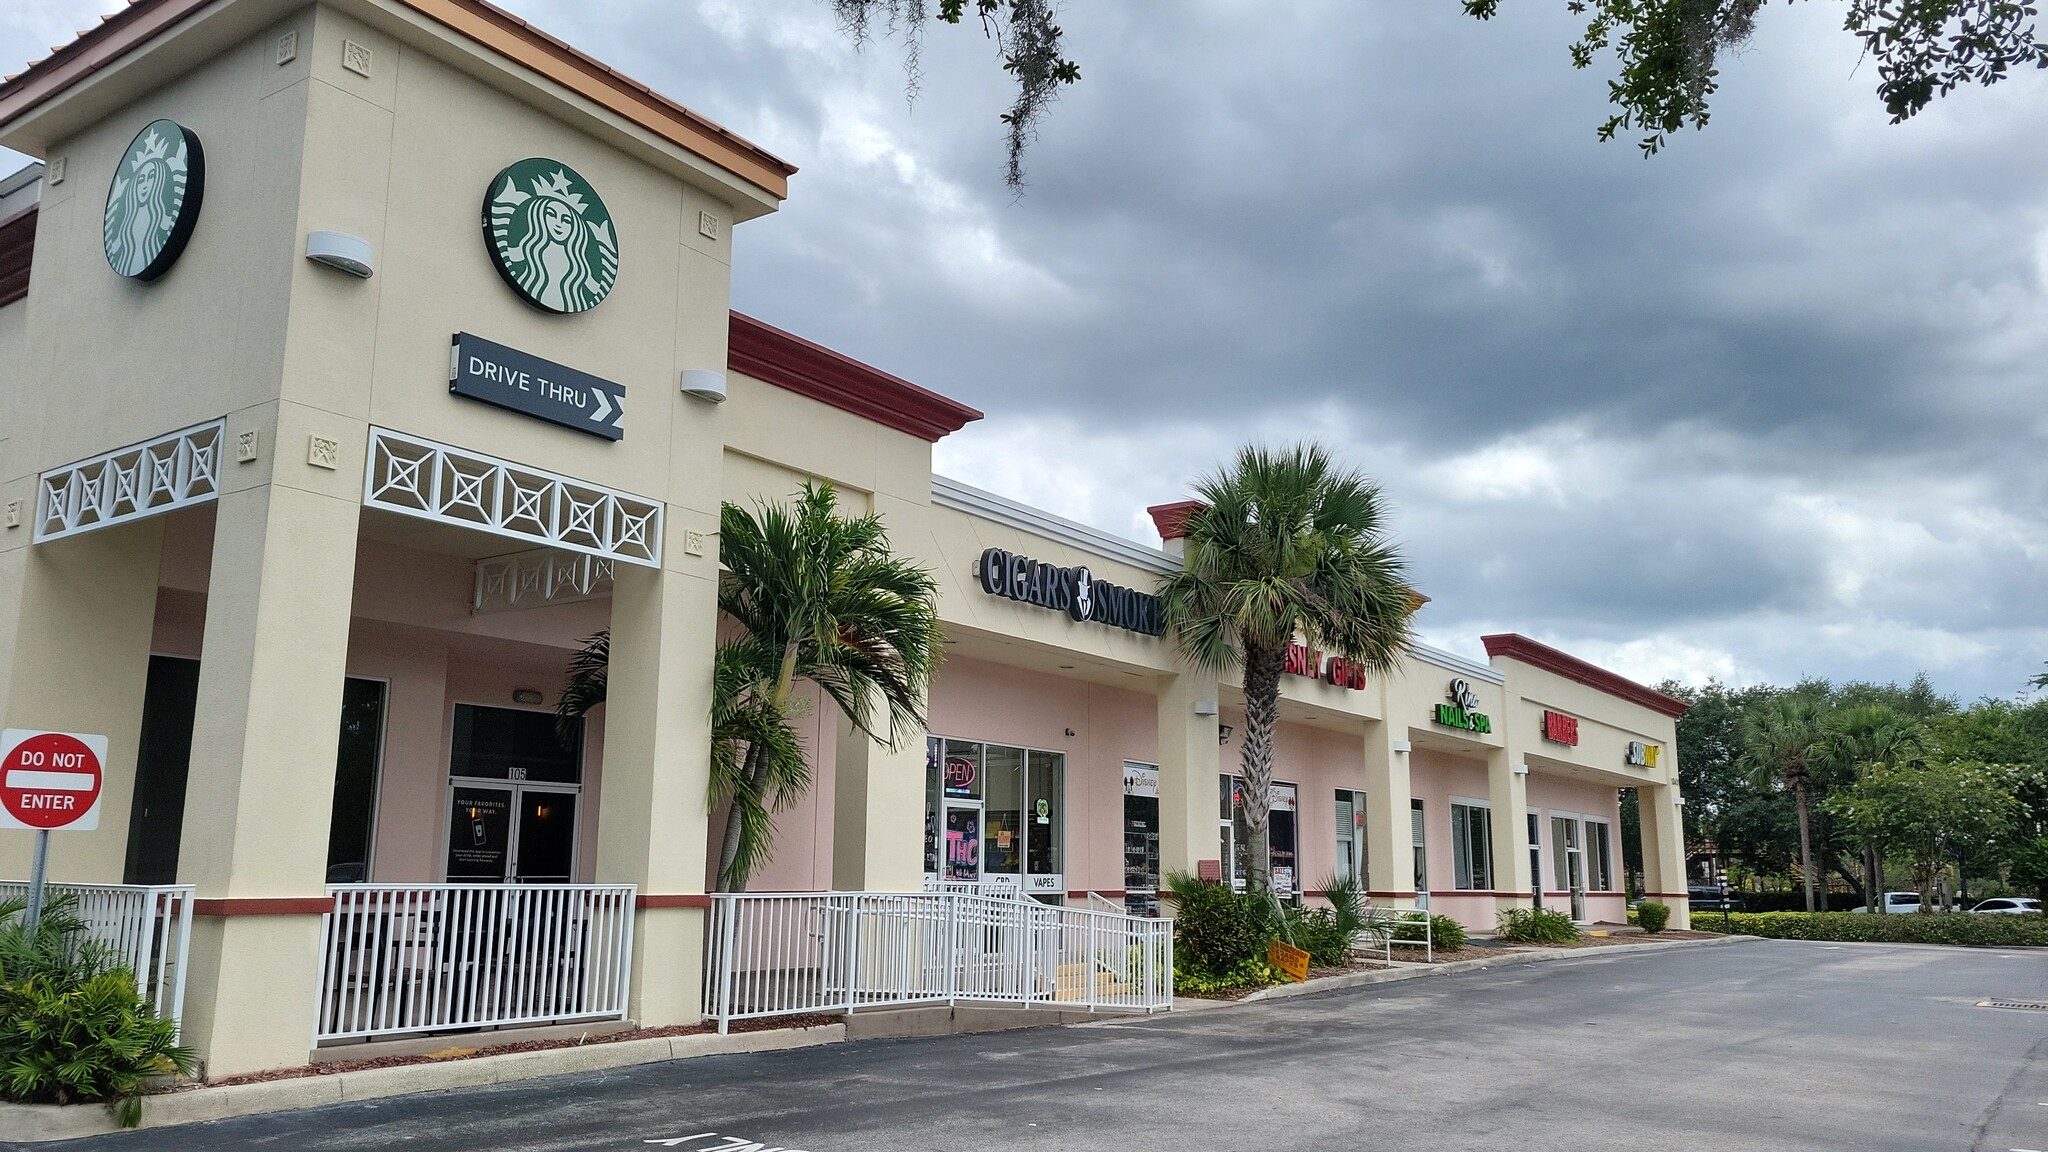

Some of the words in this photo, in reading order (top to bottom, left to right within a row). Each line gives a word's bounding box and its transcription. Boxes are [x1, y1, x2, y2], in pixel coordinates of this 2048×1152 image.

[469, 356, 530, 392] DRIVE
[537, 378, 587, 408] THRU
[980, 547, 1072, 612] CIGARS
[1439, 705, 1469, 729] NAILS
[1475, 712, 1491, 733] SPA
[1546, 711, 1578, 746] BARBERS
[21, 751, 45, 766] DO
[52, 753, 85, 768] NOT
[1629, 741, 1659, 768] SUBWAY
[510, 769, 526, 780] 105
[944, 763, 969, 781] OPEN
[21, 794, 75, 810] ENTER
[946, 830, 978, 866] THC
[1034, 878, 1055, 887] VAPES
